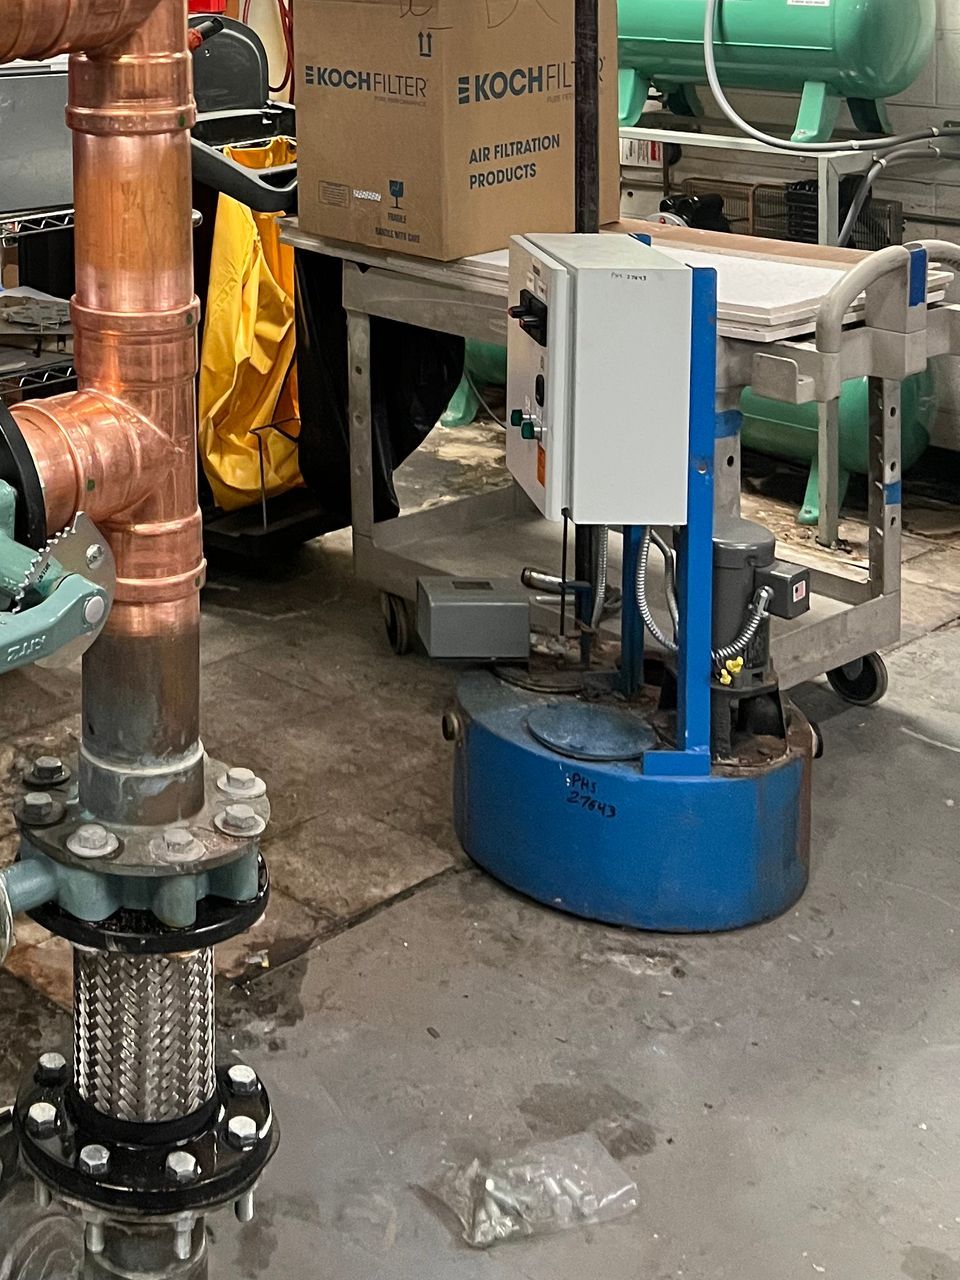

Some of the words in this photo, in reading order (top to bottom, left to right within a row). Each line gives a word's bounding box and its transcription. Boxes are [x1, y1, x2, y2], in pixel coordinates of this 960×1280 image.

[317, 66, 428, 98] KOCHFILTER
[469, 146, 491, 165] AIR
[494, 133, 560, 160] FILTRATION
[469, 162, 537, 190] PRODUCTS
[572, 772, 597, 794] PHS
